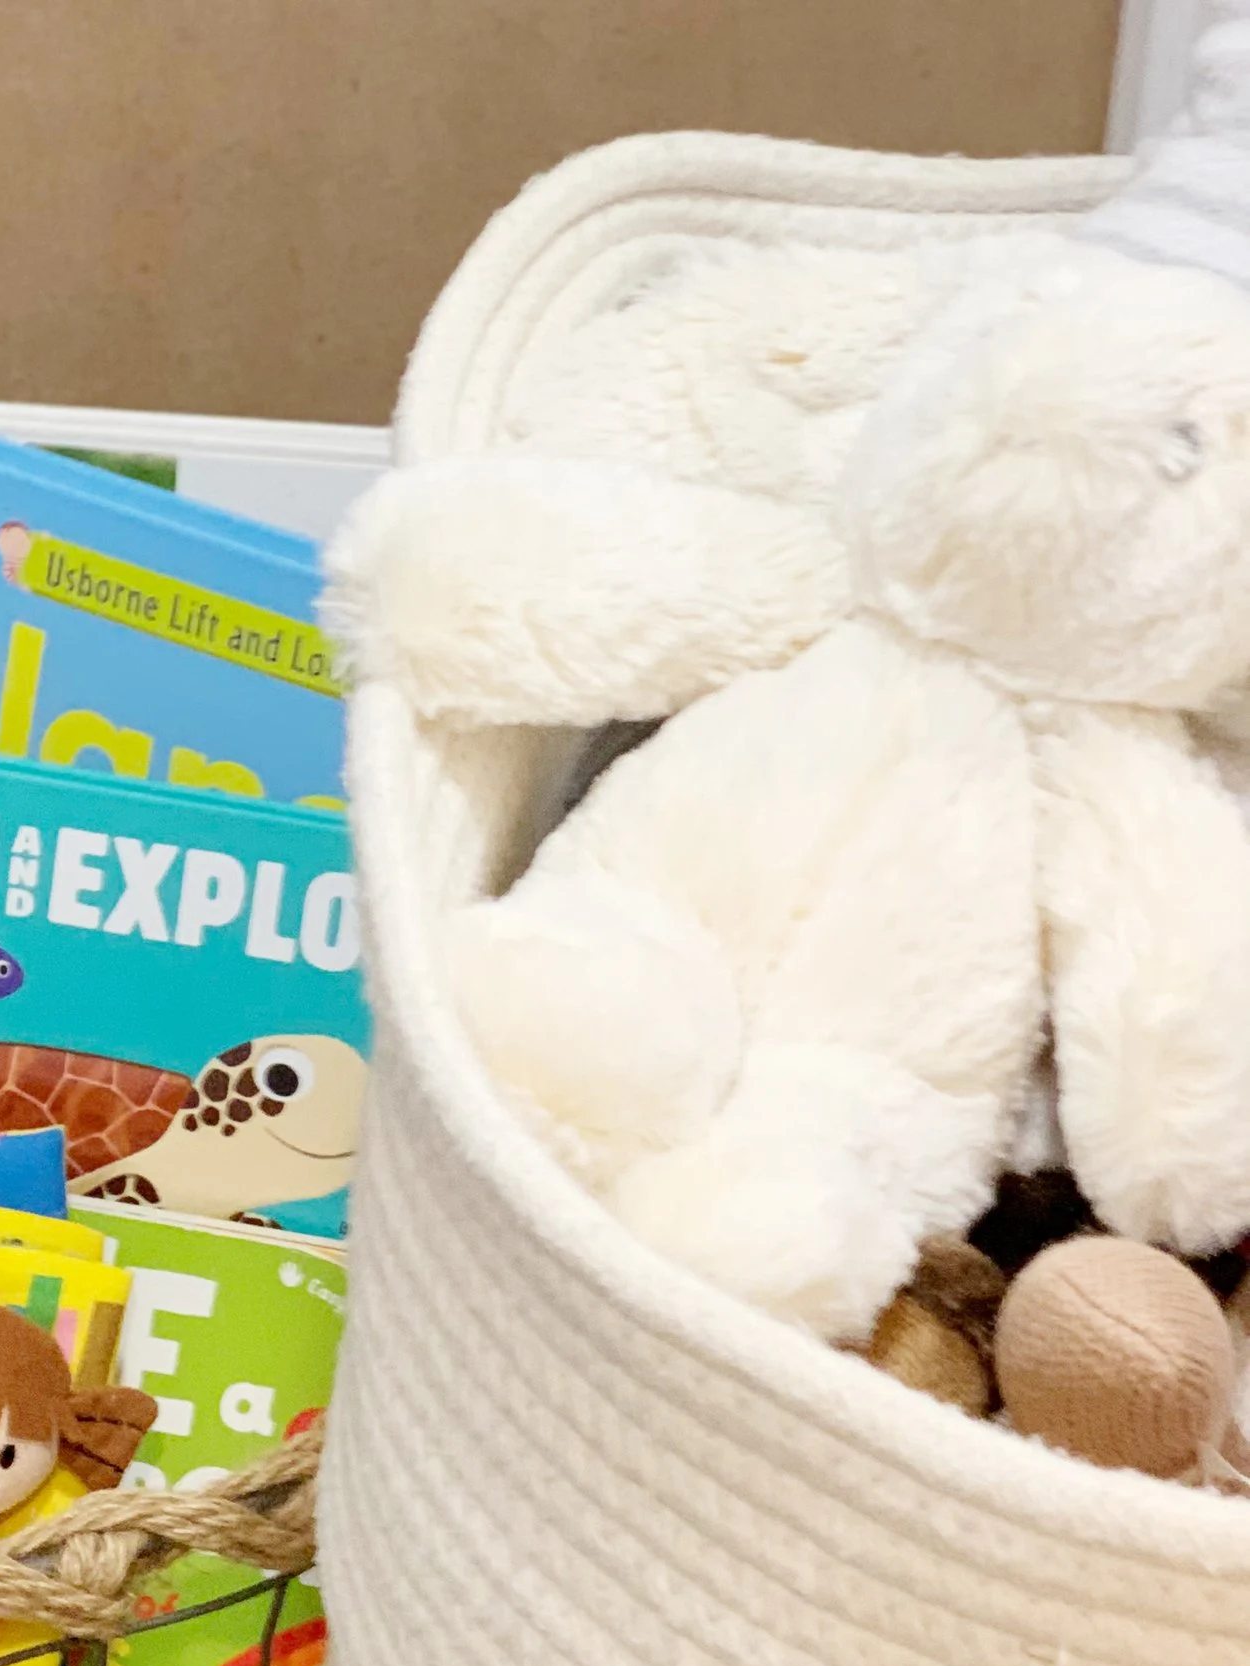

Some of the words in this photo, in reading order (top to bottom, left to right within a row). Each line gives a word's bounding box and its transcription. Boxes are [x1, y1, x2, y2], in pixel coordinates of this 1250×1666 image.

[46, 551, 159, 621] Usborne
[169, 594, 220, 643] Lift
[227, 625, 284, 664] and
[5, 824, 41, 918] AND
